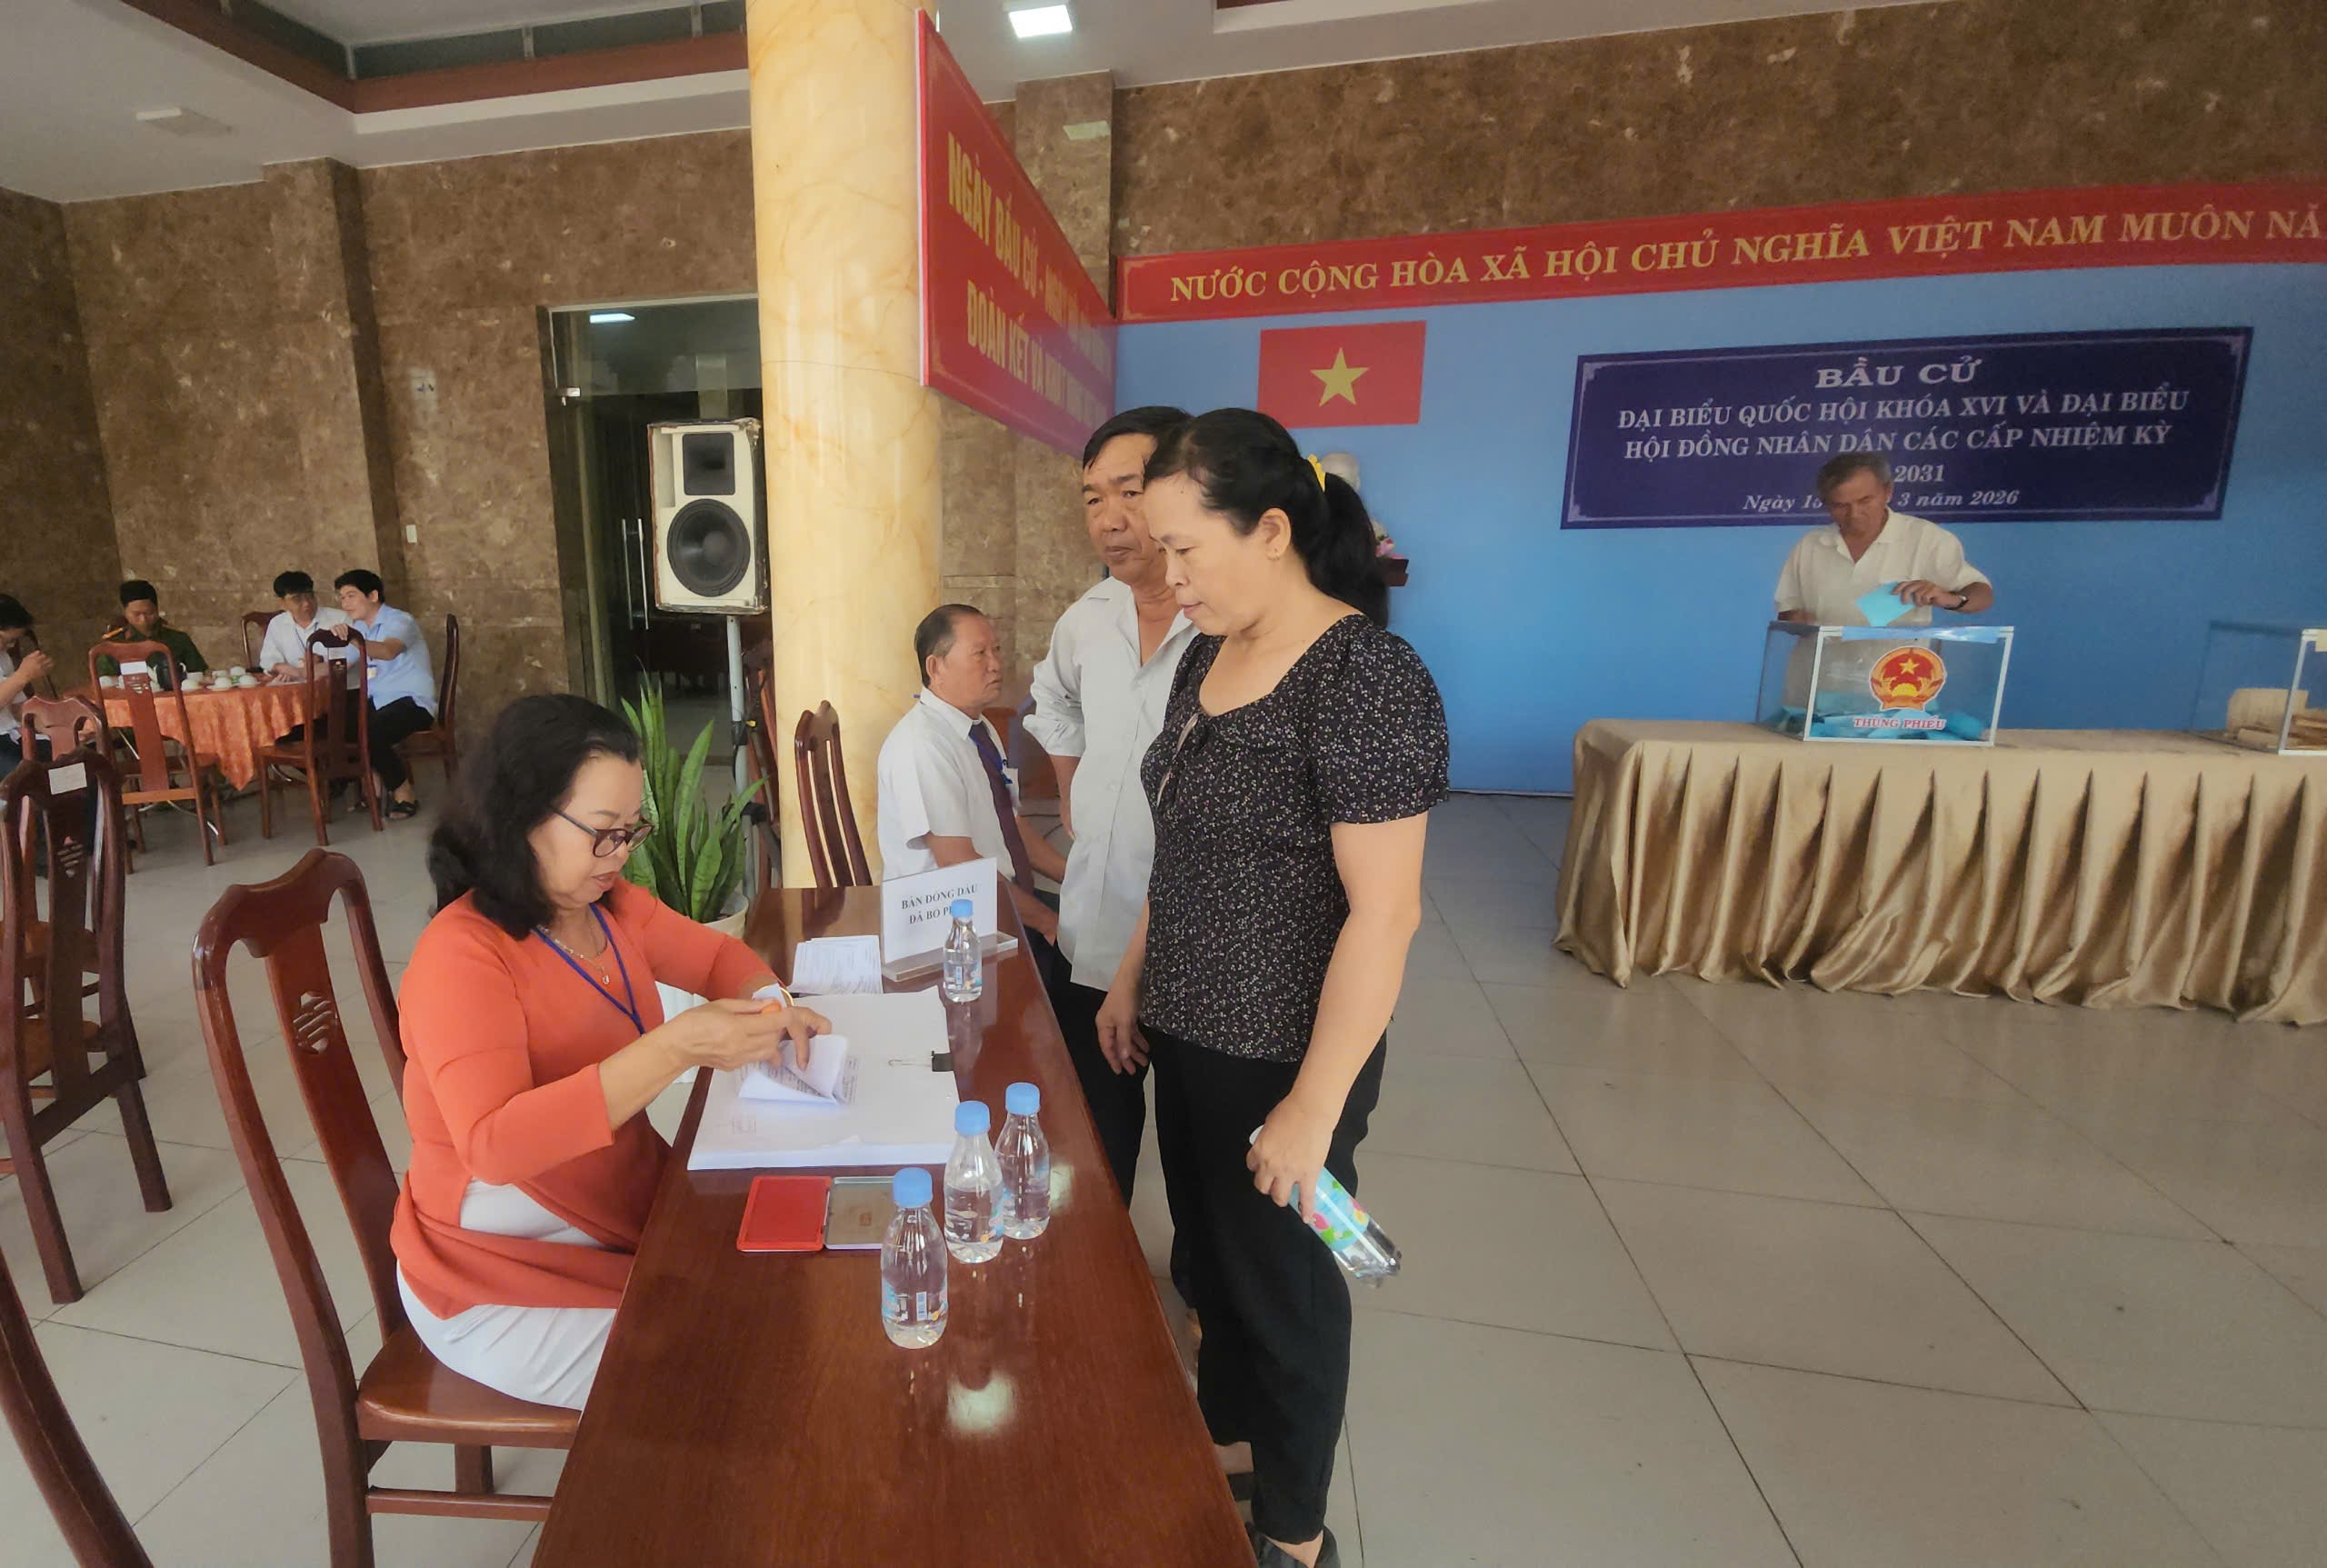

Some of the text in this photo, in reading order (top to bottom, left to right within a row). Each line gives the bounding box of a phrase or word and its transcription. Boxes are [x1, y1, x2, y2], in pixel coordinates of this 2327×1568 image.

[948, 131, 992, 246] NGÀY
[1171, 203, 2326, 301] NƯỚC CỘNG HÒA XÃ HỘI CHỦ NGHĨA VIỆT NAM MUÔN NĂ
[967, 279, 1005, 369] ĐOÀN
[1009, 312, 1030, 385] KẾT
[1814, 355, 1982, 388] BẦU CỬ
[1617, 381, 2190, 433] ĐẠI BIỂU QUỐC HỘI KHÓA XVI VÀ ĐẠI BIỂU
[1624, 419, 2173, 463] HỘI ĐỒNG NHÂN DÂN CÁC CẤP NHIỆM KỲ
[1894, 464, 1945, 483] 2031
[1743, 494, 1795, 513] Ngày
[1916, 492, 1963, 507] năm
[1970, 490, 2021, 505] 2026
[1853, 715, 1945, 728] THÙNG PHIẾU
